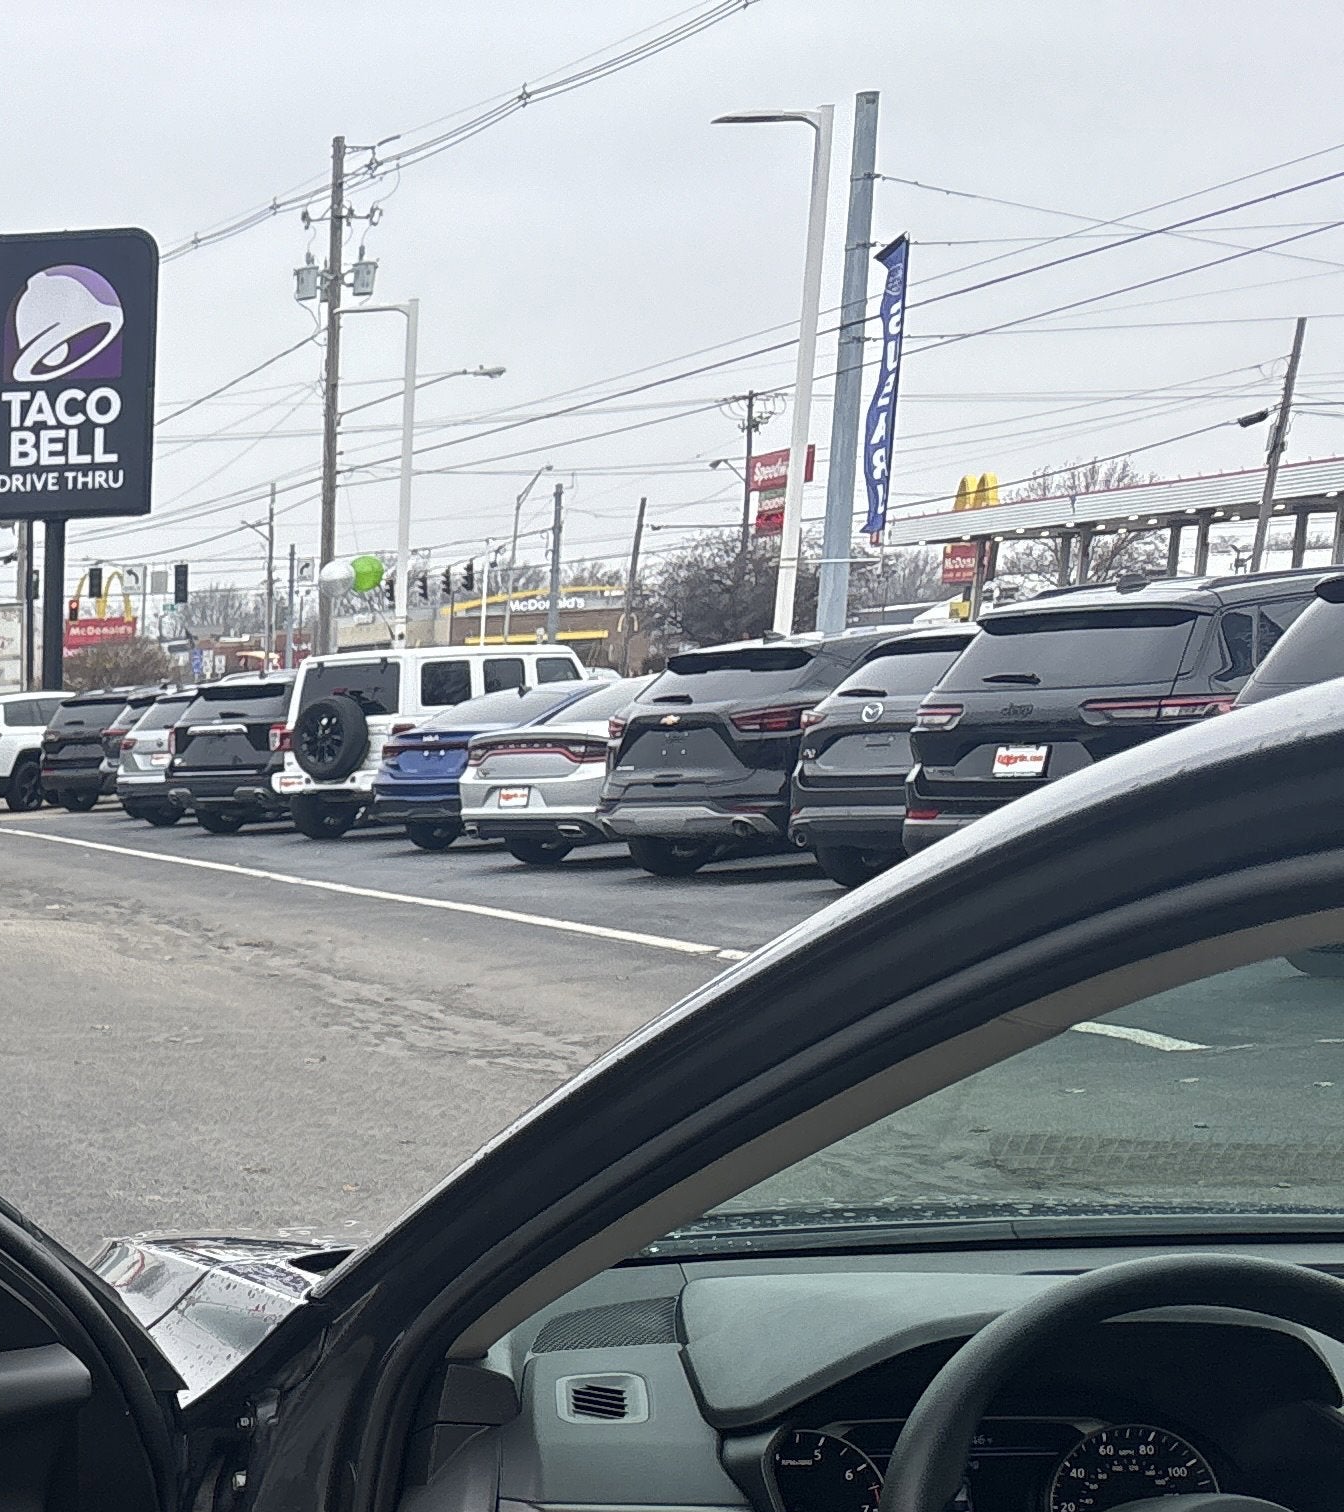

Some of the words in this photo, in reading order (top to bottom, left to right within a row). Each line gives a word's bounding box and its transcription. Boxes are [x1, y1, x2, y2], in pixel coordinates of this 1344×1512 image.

[1, 387, 122, 428] TACO
[9, 427, 119, 467] BELL
[63, 469, 124, 490] THRU
[69, 624, 133, 637] McDonald's
[814, 1449, 822, 1461] 5
[1099, 1445, 1114, 1456] 60
[1139, 1445, 1155, 1455] 80
[845, 1469, 853, 1481] 6
[1070, 1468, 1085, 1479] 40
[1167, 1467, 1188, 1477] 100
[1060, 1502, 1076, 1512] 20
